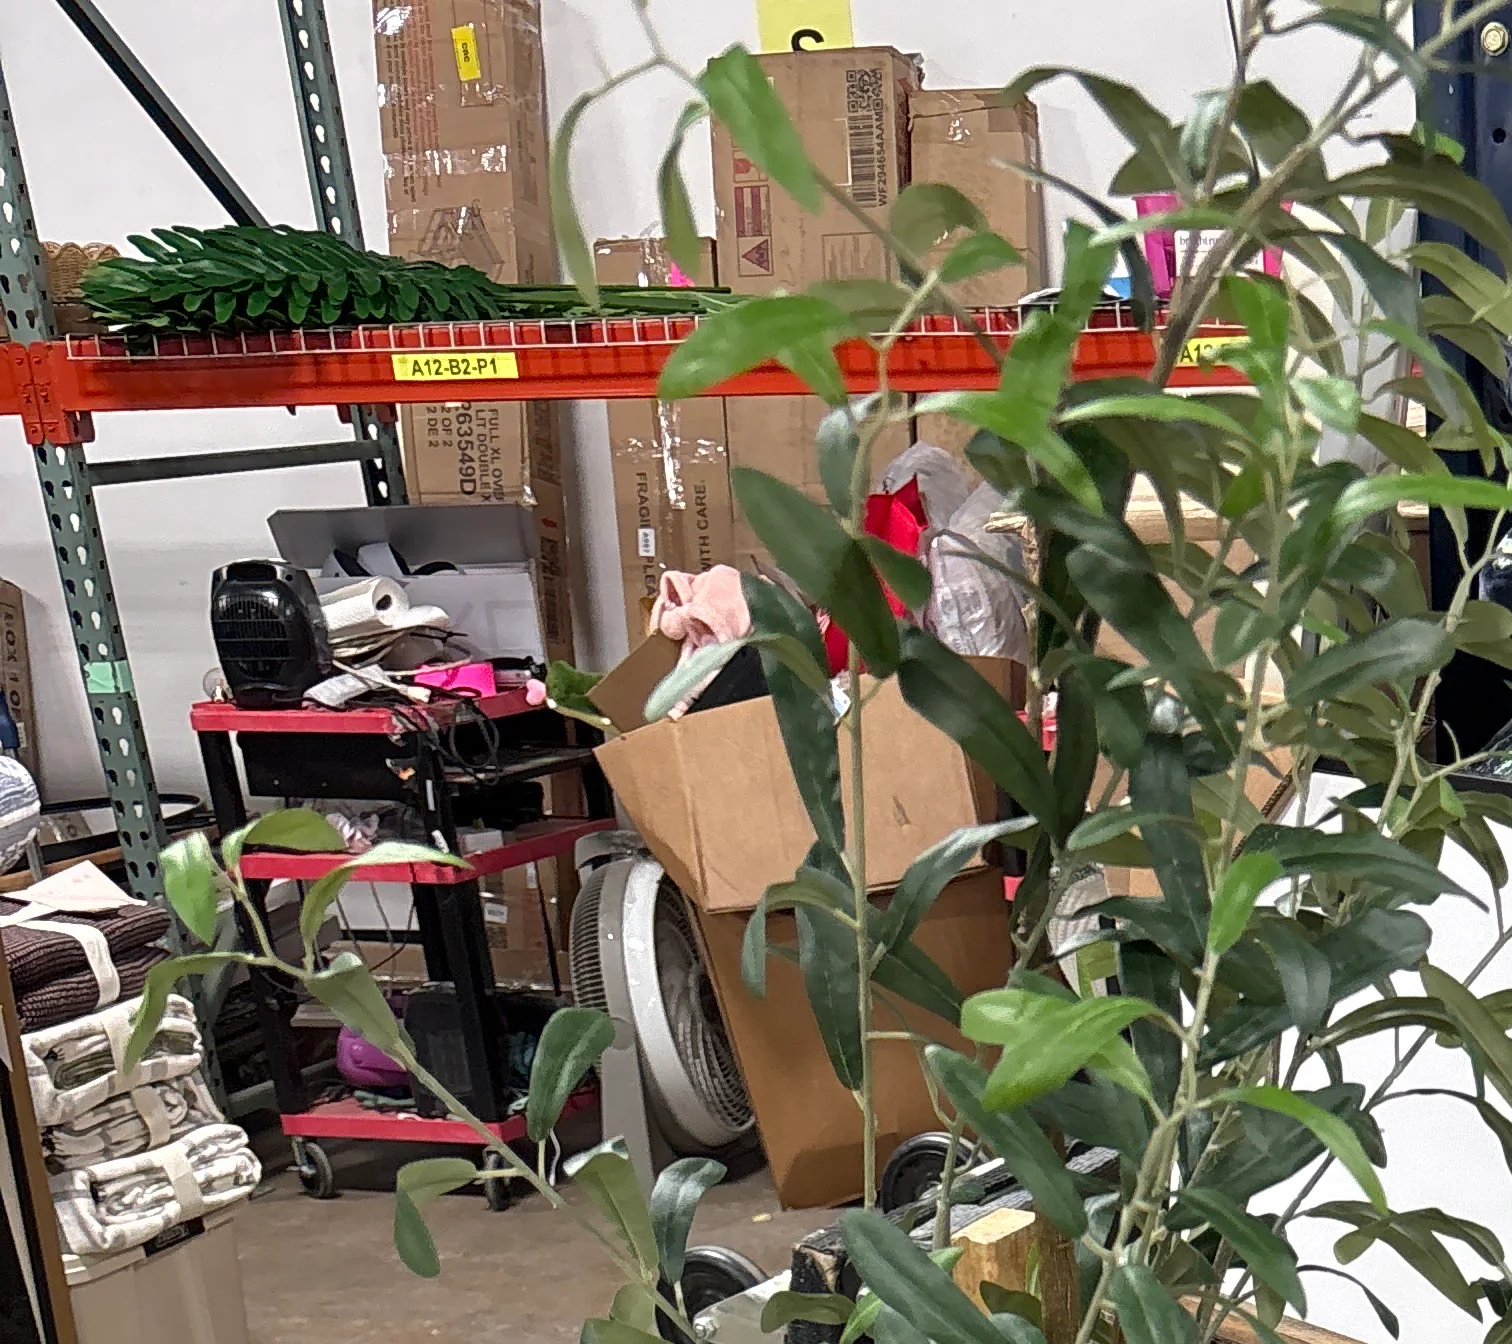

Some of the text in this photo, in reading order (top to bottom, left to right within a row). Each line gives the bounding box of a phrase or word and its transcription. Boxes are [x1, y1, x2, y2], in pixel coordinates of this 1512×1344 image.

[411, 357, 498, 376] A12-B2-P1
[427, 418, 439, 436] DE
[441, 418, 453, 437] OF
[475, 409, 487, 429] LIT
[487, 408, 501, 443] FULL
[476, 433, 492, 490] DOUBLE
